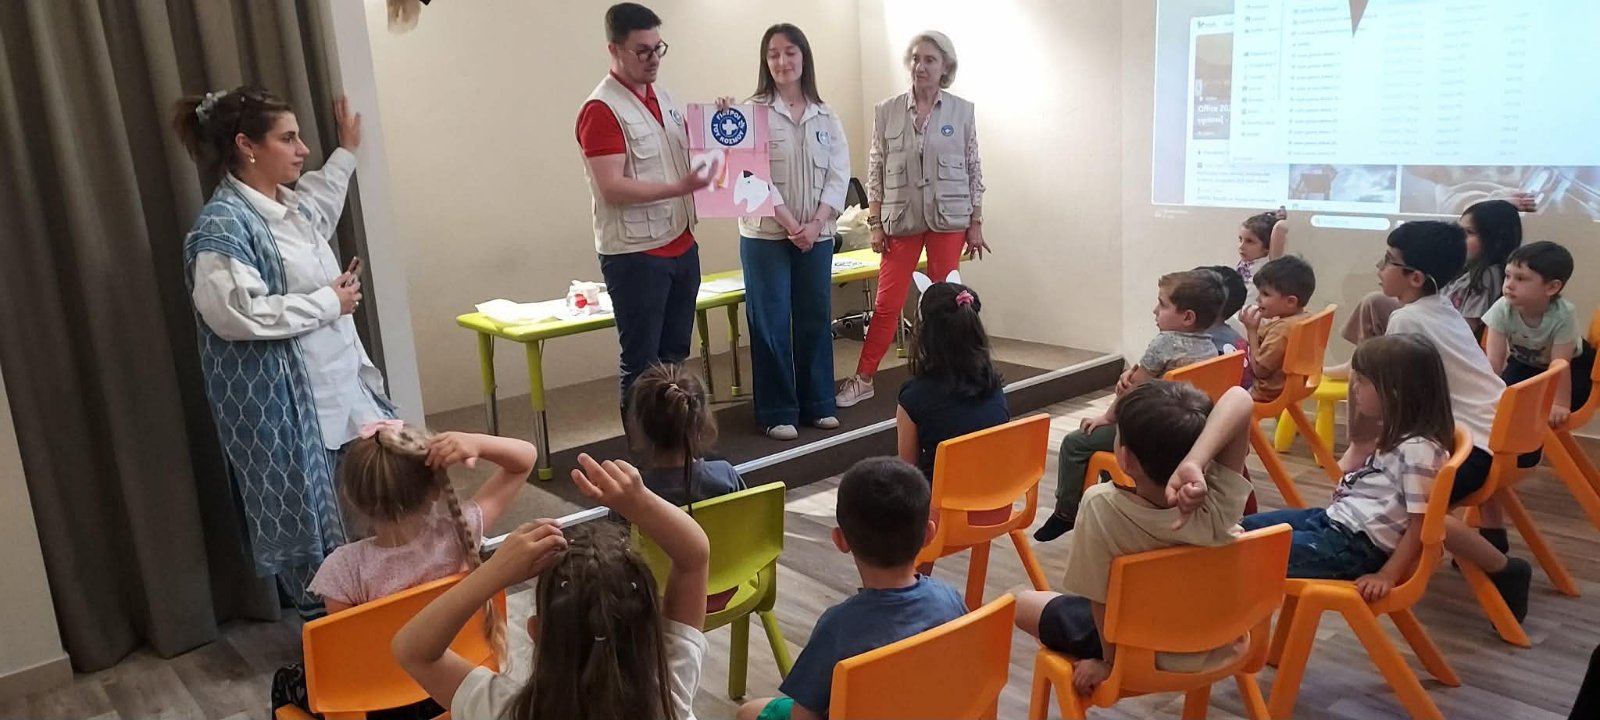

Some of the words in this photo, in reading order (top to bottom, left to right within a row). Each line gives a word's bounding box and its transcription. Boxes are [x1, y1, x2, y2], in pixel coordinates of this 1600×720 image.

[1198, 104, 1218, 112] Office
[713, 123, 721, 136] ΤΟΥ
[719, 130, 744, 145] ΚΟΣΜΟΥ
